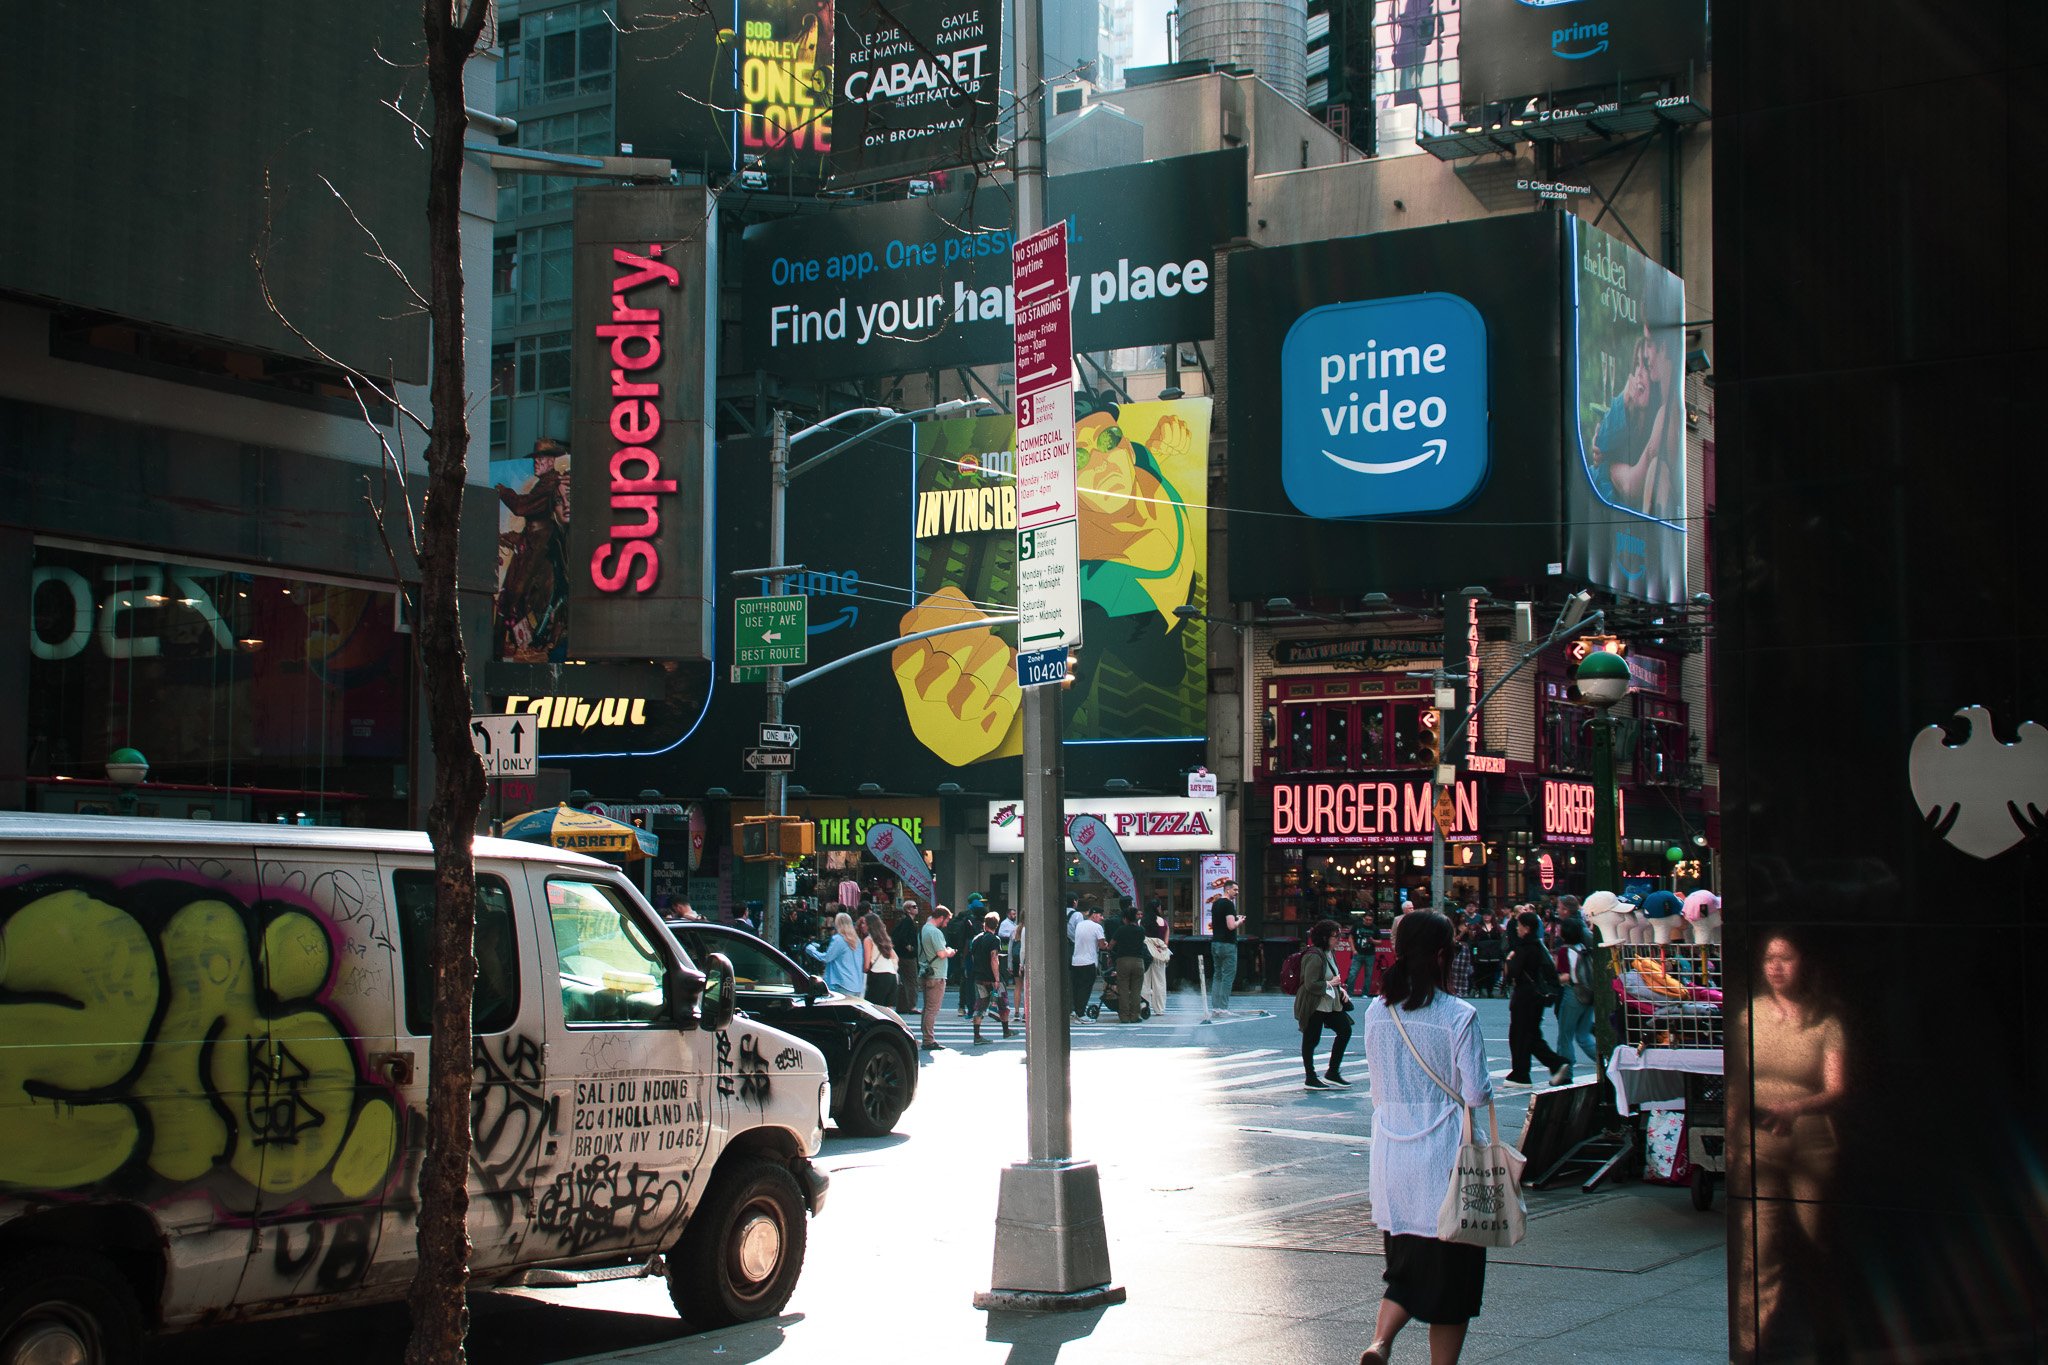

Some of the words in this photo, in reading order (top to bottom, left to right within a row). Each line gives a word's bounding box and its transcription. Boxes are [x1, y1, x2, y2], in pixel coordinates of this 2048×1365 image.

[745, 20, 771, 39] BOB
[941, 10, 979, 29] GAYLE
[936, 24, 984, 45] RANKIN
[1551, 20, 1609, 49] prime
[745, 39, 800, 60] MARLEY
[743, 58, 814, 105] ONE
[844, 44, 988, 104] CABARET
[906, 91, 926, 106] KIT
[927, 86, 949, 102] KAT
[949, 80, 981, 98] CUB
[1656, 94, 1690, 108] 022241
[743, 103, 832, 153] LOVE
[865, 135, 885, 147] ON
[890, 118, 966, 143] BROADWAY
[1530, 180, 1554, 193] Clear
[1554, 182, 1591, 194] Channel
[1015, 247, 1026, 264] NO
[1026, 232, 1060, 258] STANDING
[771, 257, 820, 286] One
[825, 254, 879, 283] app.
[885, 241, 937, 271] One
[1016, 257, 1044, 279] Anytime
[1583, 251, 1597, 273] the
[1597, 241, 1627, 290] idea
[771, 297, 847, 348] Find
[856, 292, 945, 345] your
[1090, 258, 1209, 314] place
[1017, 310, 1027, 327] NO
[1028, 297, 1062, 322] STANDING
[1600, 289, 1610, 307] of
[1610, 287, 1637, 322] you
[1017, 328, 1037, 344] Monday
[1041, 321, 1057, 336] Friday
[1320, 338, 1447, 395] prime
[591, 244, 680, 592] Superdry.
[1020, 399, 1031, 425] 3
[1320, 388, 1448, 437] video
[1020, 429, 1063, 452] COMMERCIAL
[1020, 449, 1051, 468] VEHICLES
[1053, 442, 1071, 458] ONLY
[1020, 475, 1039, 487] Monday
[1043, 469, 1060, 481] Friday
[915, 485, 1017, 539] INVINCIB
[1021, 532, 1032, 559] 5
[1022, 568, 1042, 580] Monday
[1047, 564, 1065, 575] Friday
[1038, 576, 1060, 590] Midnight
[740, 599, 803, 615] SOUTHBOUND
[1022, 599, 1046, 611] Saturday
[1039, 607, 1061, 621] Midnight
[745, 616, 764, 628] USE
[769, 616, 775, 627] 7
[779, 614, 797, 626] AVE
[741, 649, 765, 662] BEST
[770, 647, 801, 660] ROUTE
[1290, 639, 1368, 661] PLAYWRIGHT
[746, 667, 751, 680] 7
[766, 731, 779, 740] ONE
[784, 732, 795, 742] WAY
[503, 758, 532, 770] ONLY
[751, 754, 764, 764] ONE
[771, 755, 788, 765] WAY
[1465, 755, 1506, 773] TAVERN
[1273, 782, 1398, 835] BURGER
[1403, 780, 1478, 833] MN
[1545, 781, 1595, 835] BURGER
[820, 818, 851, 845] THE
[1114, 811, 1213, 837] PIZZA
[555, 834, 628, 850] SABRETT
[883, 853, 907, 876] RAY'S
[1085, 847, 1109, 873] RAY'S
[643, 1079, 688, 1103] NDONG
[574, 1132, 624, 1157] BRONX
[629, 1130, 650, 1152] NY
[659, 1128, 703, 1151] 10462
[1461, 1219, 1509, 1231] BAGELS
